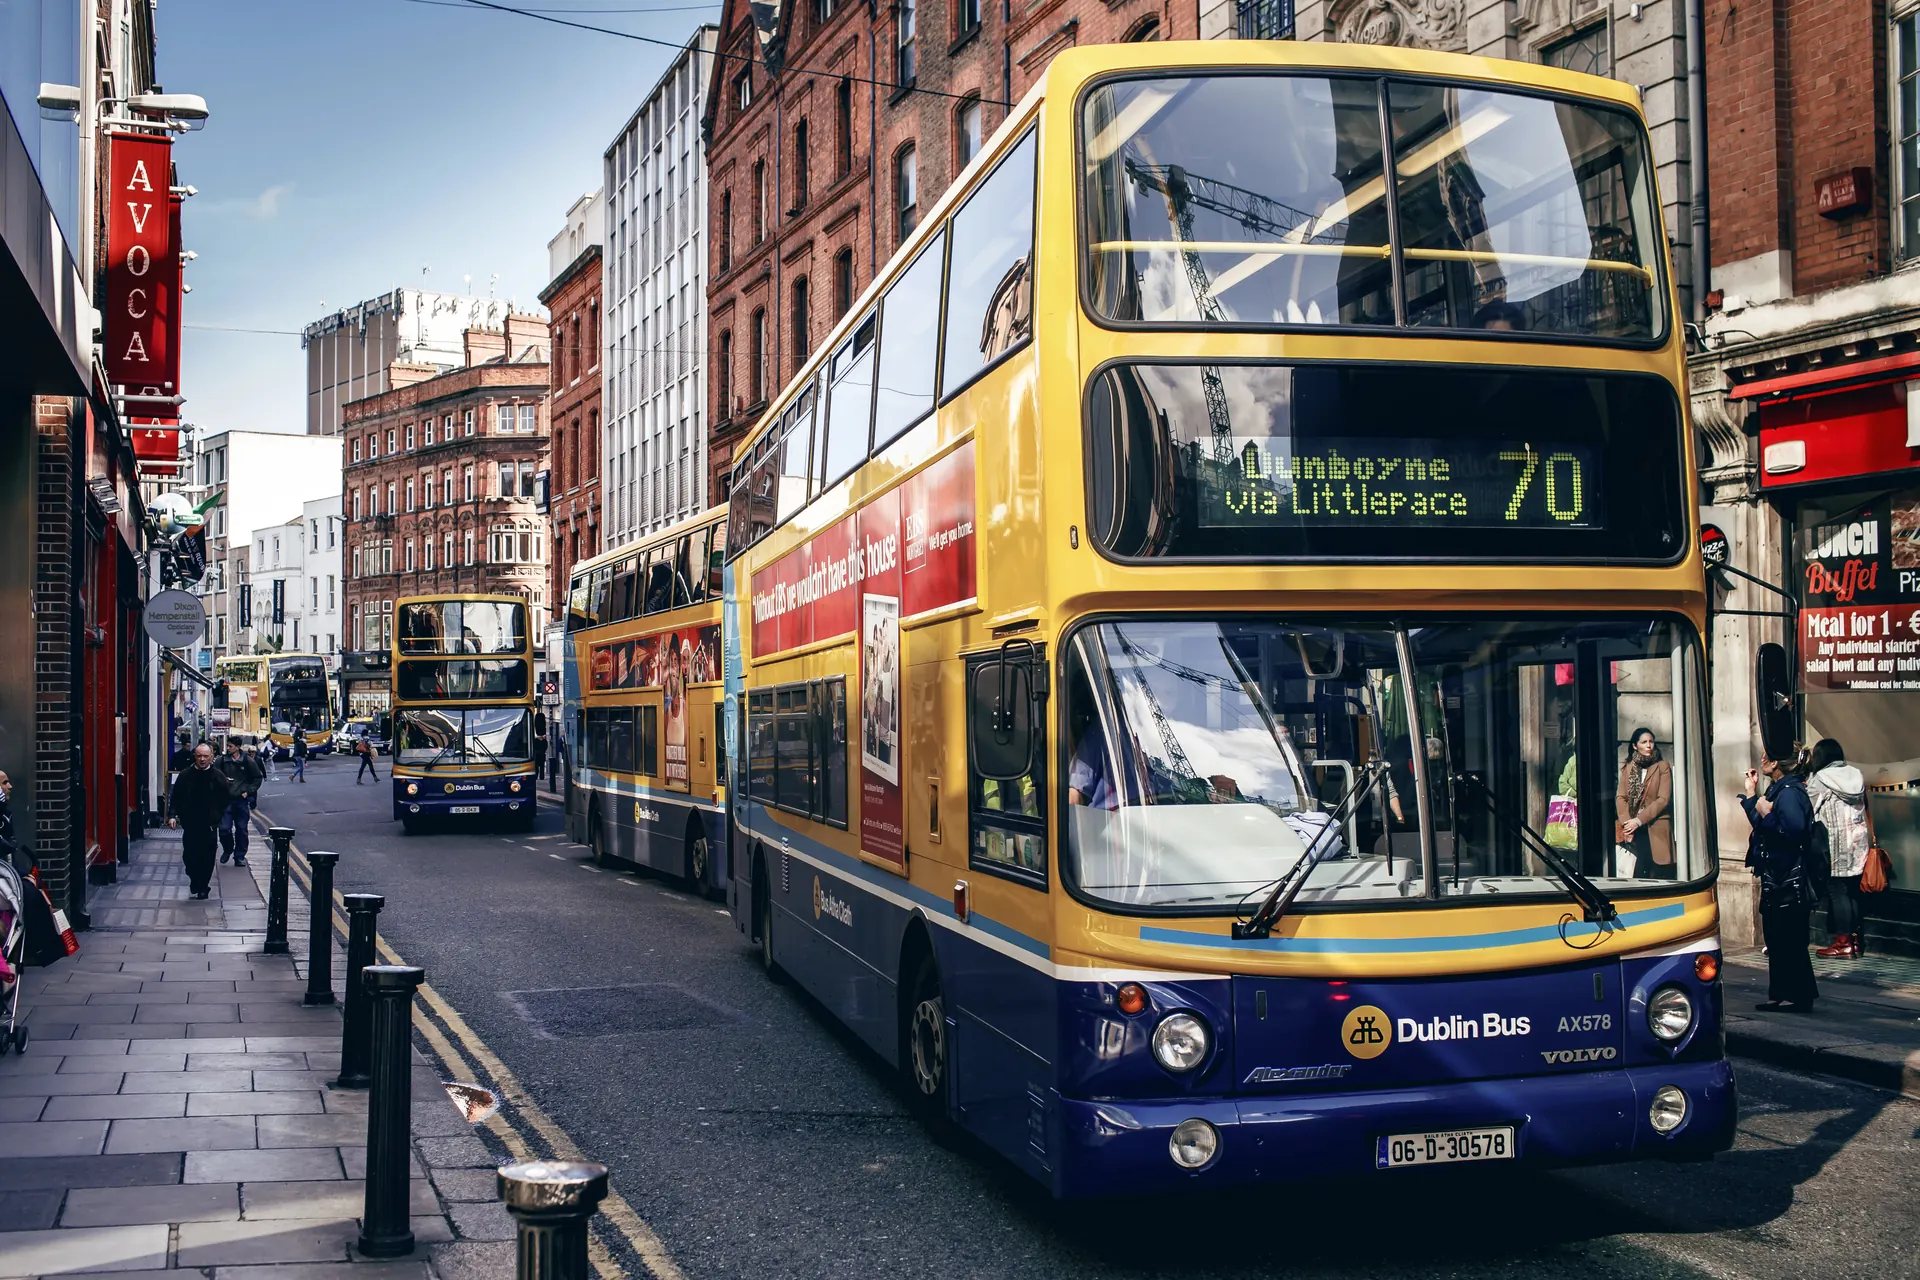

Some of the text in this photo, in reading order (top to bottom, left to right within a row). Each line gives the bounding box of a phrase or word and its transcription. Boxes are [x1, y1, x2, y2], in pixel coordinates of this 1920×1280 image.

[122, 160, 153, 362] AVOCA
[1246, 448, 1450, 481] Dunboyne
[1226, 483, 1277, 515] via
[1499, 452, 1583, 520] 70
[928, 520, 974, 551] We'll get you home.
[1804, 520, 1879, 560] LUNCH
[775, 581, 787, 616] EBS
[787, 583, 797, 612] we
[797, 559, 828, 607] wouldn't
[827, 555, 847, 595] have
[848, 540, 865, 586] this
[1805, 559, 1879, 602] Buffet
[148, 612, 200, 622] Hempenstall
[174, 602, 197, 611] Dixon
[166, 623, 196, 631] Opticians
[1807, 612, 1845, 638] Meal
[1850, 611, 1876, 637] for
[1880, 610, 1890, 636] 1
[1818, 641, 1835, 657] Any
[1837, 639, 1883, 655] individual
[1806, 658, 1830, 673] salad
[1832, 657, 1855, 673] bowl
[1856, 657, 1876, 672] and
[1877, 658, 1894, 674] any
[1880, 680, 1892, 689] cost
[1892, 680, 1902, 689] for
[820, 888, 853, 927] Bus Átha Cliath
[1397, 1012, 1531, 1043] Dublin Bus
[1557, 1014, 1612, 1033] AX578
[1540, 1047, 1617, 1065] VOLVO
[1243, 1064, 1352, 1084] Alexander
[1392, 1133, 1505, 1163] 06-D-30578
